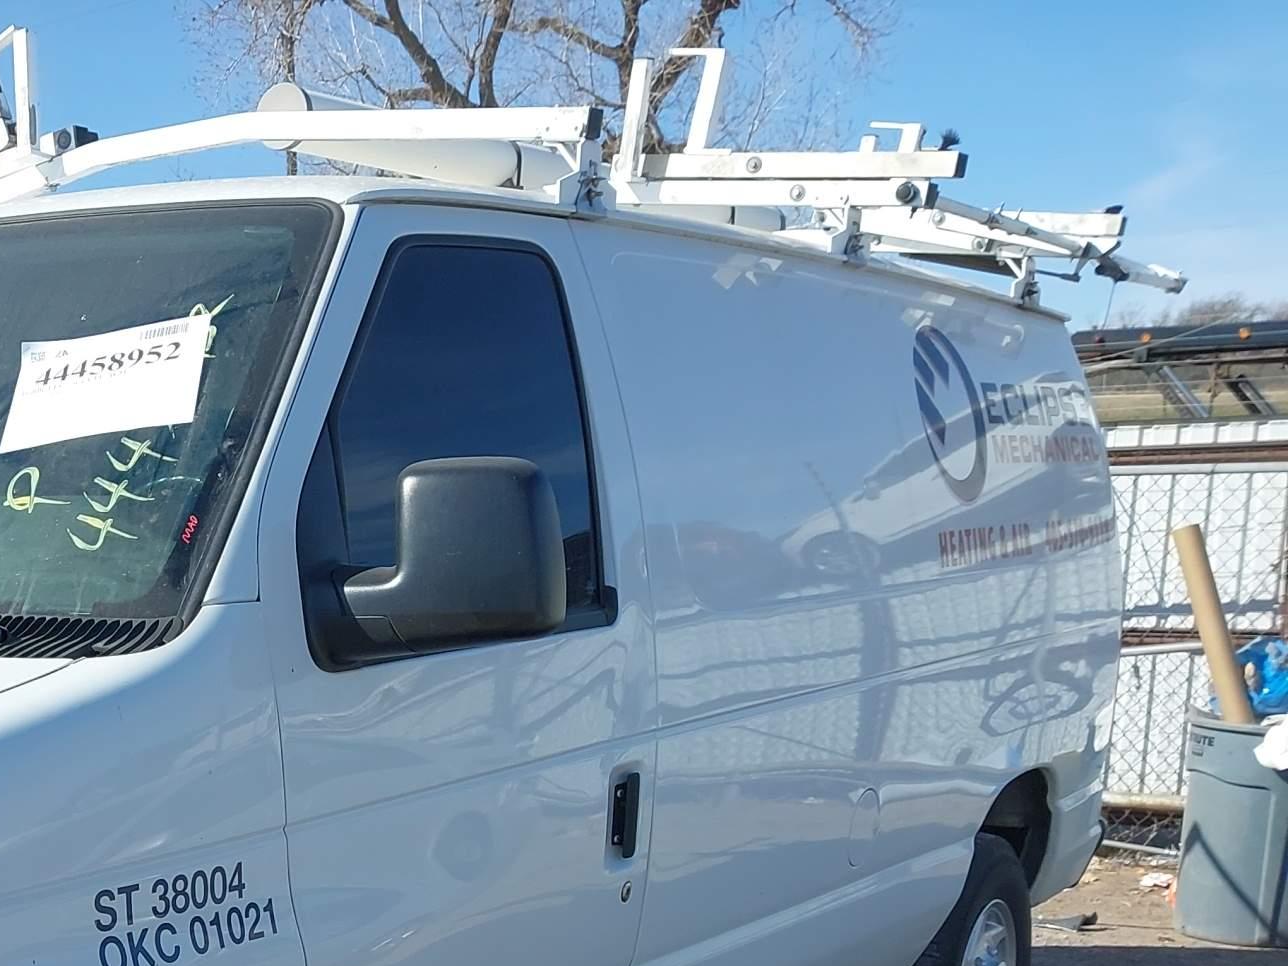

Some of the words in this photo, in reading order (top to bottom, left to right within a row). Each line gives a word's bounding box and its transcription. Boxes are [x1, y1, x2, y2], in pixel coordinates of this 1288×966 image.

[35, 342, 181, 385] 44458952
[993, 435, 1099, 464] MECHANICAL
[938, 525, 996, 569] HEATING
[94, 883, 140, 932] ST
[151, 861, 246, 918] 38004
[189, 898, 278, 955] 01021
